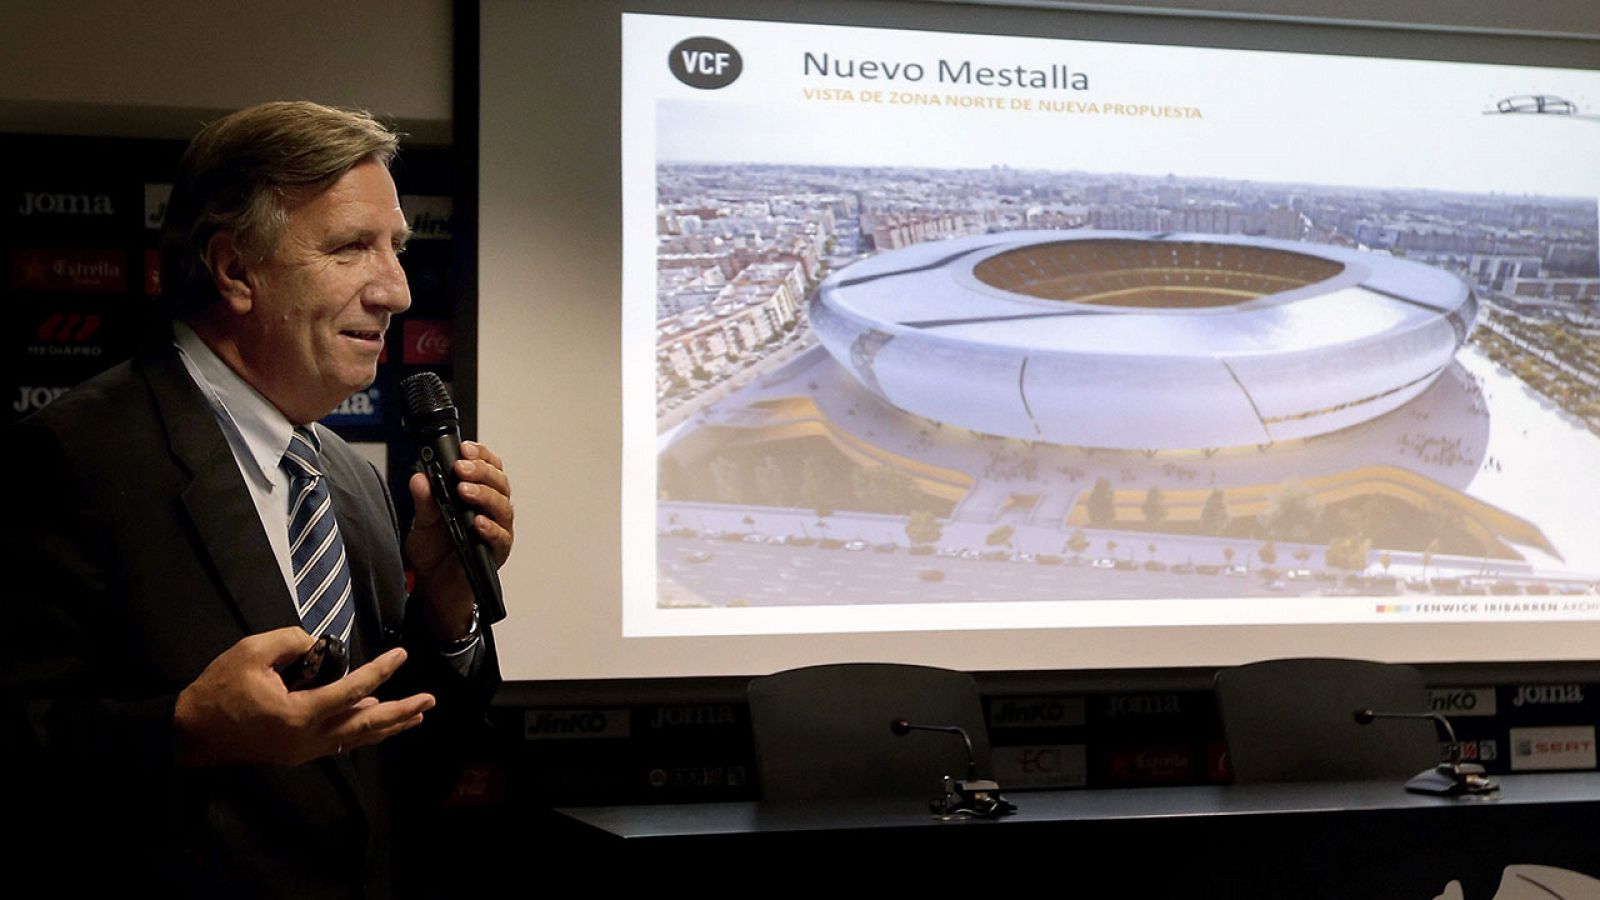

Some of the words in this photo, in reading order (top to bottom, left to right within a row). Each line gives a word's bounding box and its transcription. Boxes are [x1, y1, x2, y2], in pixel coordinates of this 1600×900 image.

[681, 49, 731, 76] VCF
[803, 51, 925, 82] Nuevo
[938, 59, 1090, 91] Mestalla
[803, 87, 854, 102] VISTA
[860, 90, 884, 104] DE
[889, 91, 942, 107] ZONA
[945, 94, 1006, 110] NORTE
[1010, 98, 1032, 111] DE
[1038, 99, 1100, 114] NUEVA
[1103, 103, 1203, 119] PROPUESTA
[1416, 603, 1478, 613] FENWICK
[1484, 602, 1558, 612] IRIBARREN
[1534, 741, 1592, 753] SEAT
